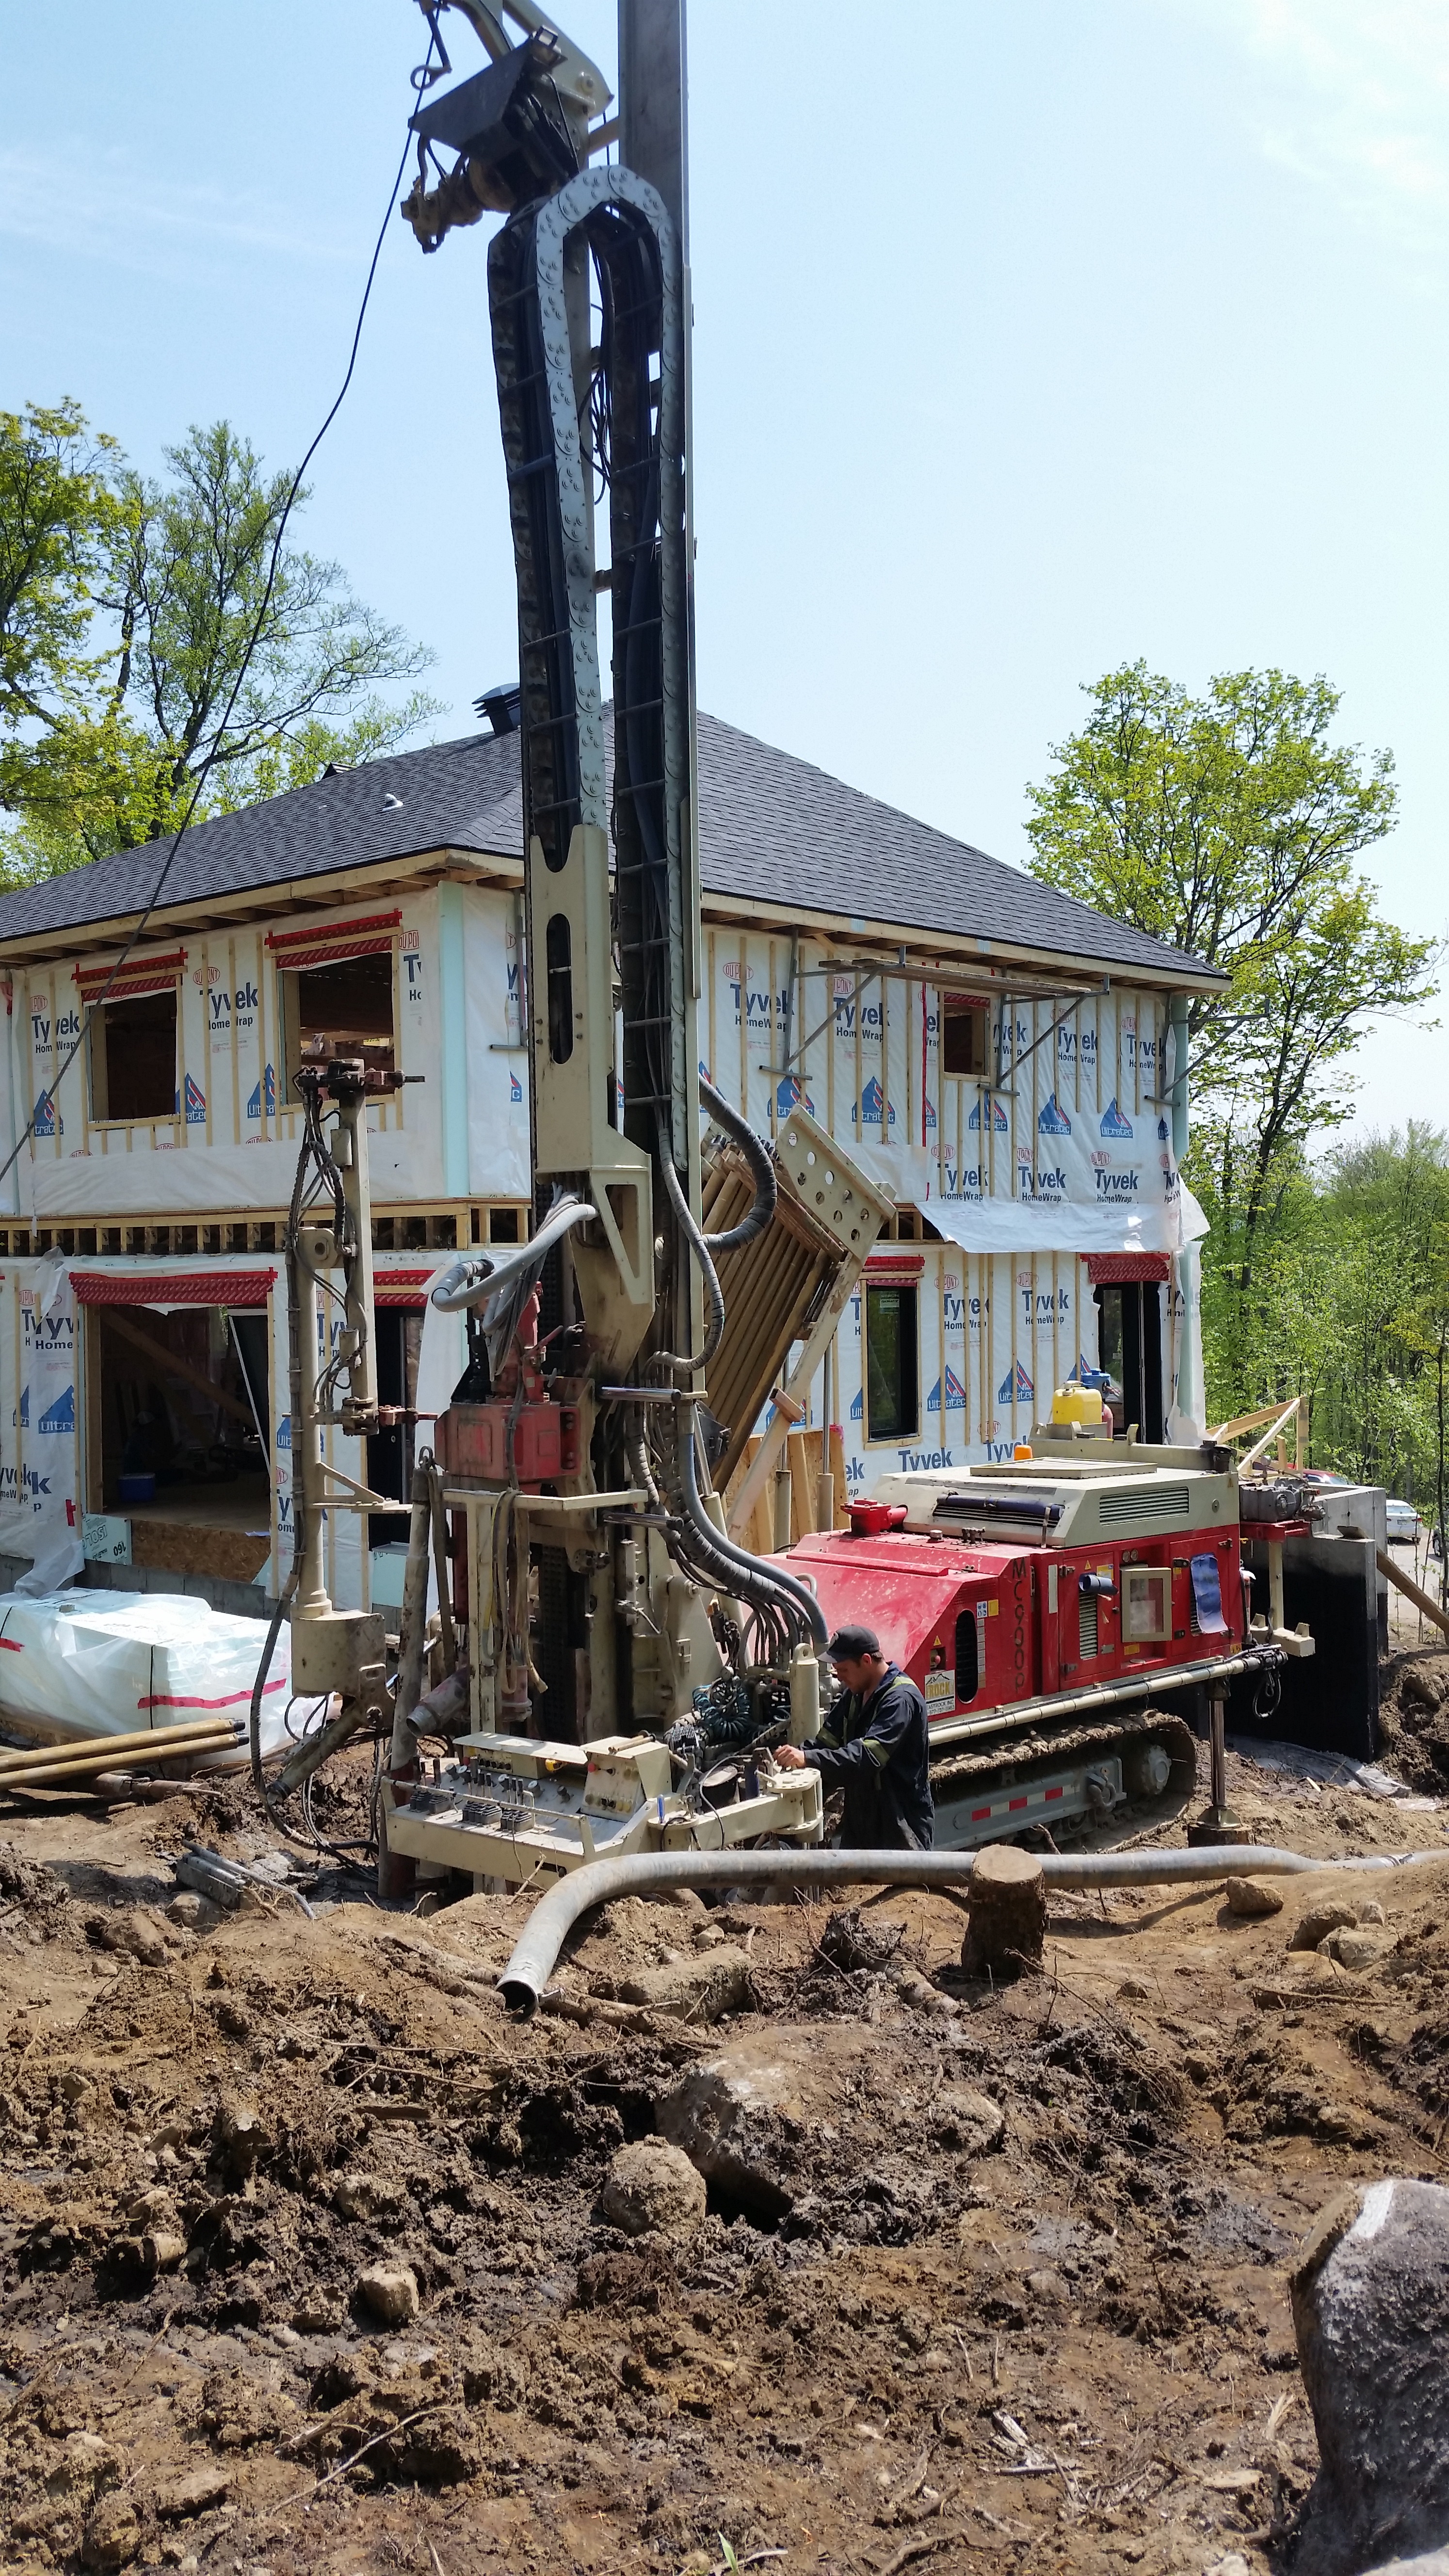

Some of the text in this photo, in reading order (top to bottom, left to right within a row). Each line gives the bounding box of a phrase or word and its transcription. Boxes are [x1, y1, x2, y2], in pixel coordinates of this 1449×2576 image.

[836, 1027, 884, 1043] HomWrap
[35, 1041, 76, 1053] HomWrap
[853, 1111, 894, 1122] Utratc
[1101, 1127, 1132, 1137] Ultratec
[1018, 1166, 1066, 1192] Tyvek
[1094, 1169, 1139, 1194] Tyvek
[1022, 1192, 1062, 1203] HomeWrap
[1097, 1194, 1132, 1204] HomeWrap
[999, 1391, 1034, 1401] Ultatec
[928, 1398, 966, 1409] Ultatec
[983, 1435, 1027, 1463] Tyv
[898, 1448, 953, 1472] Tyvek
